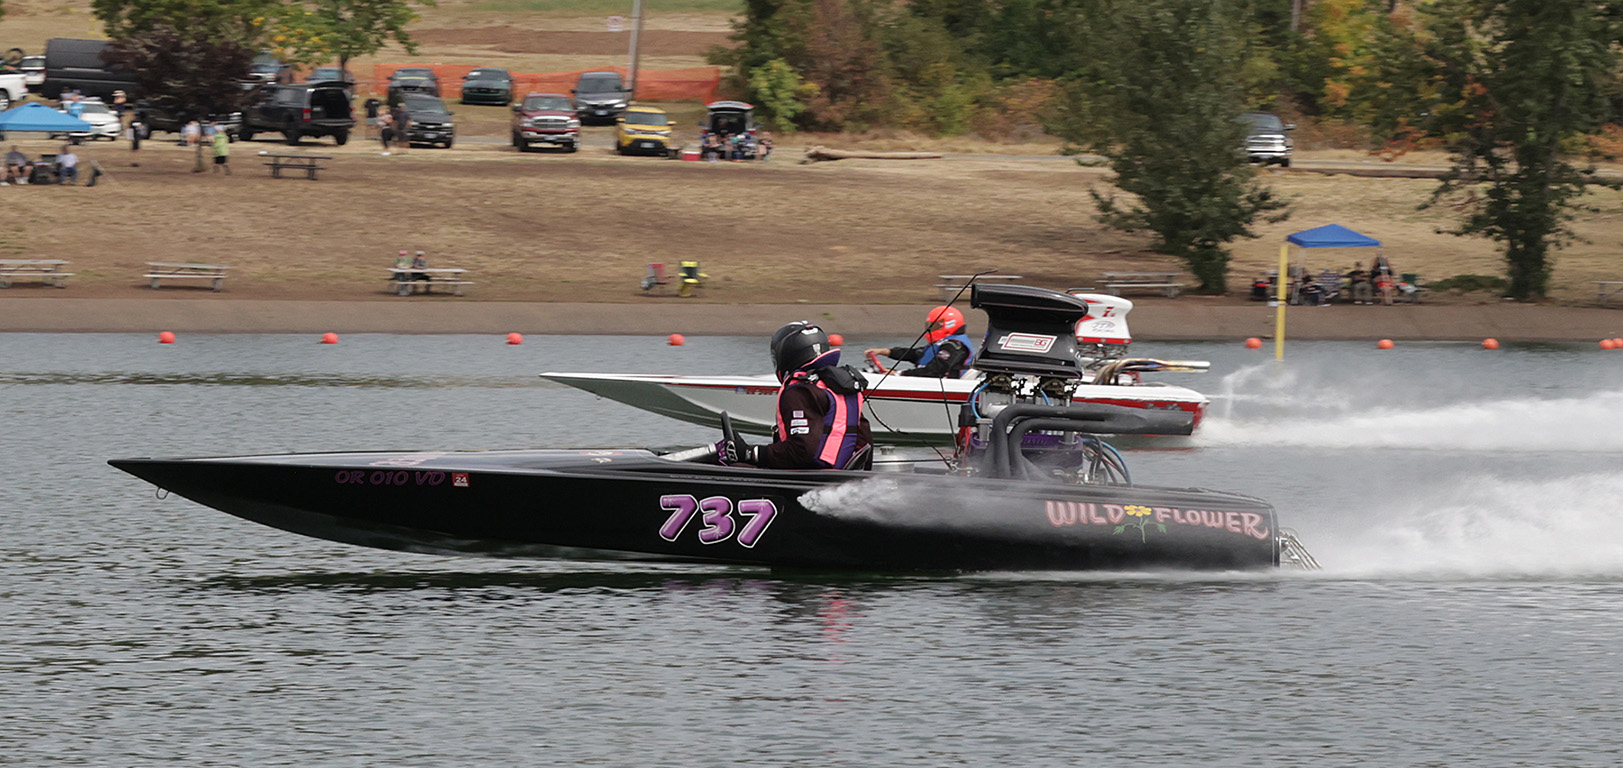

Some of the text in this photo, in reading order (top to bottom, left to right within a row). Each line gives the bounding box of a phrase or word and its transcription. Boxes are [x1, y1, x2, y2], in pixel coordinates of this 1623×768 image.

[335, 470, 365, 485] OR
[415, 471, 446, 486] VD
[659, 494, 778, 549] 737
[1045, 501, 1269, 540] WILD FLOWER
